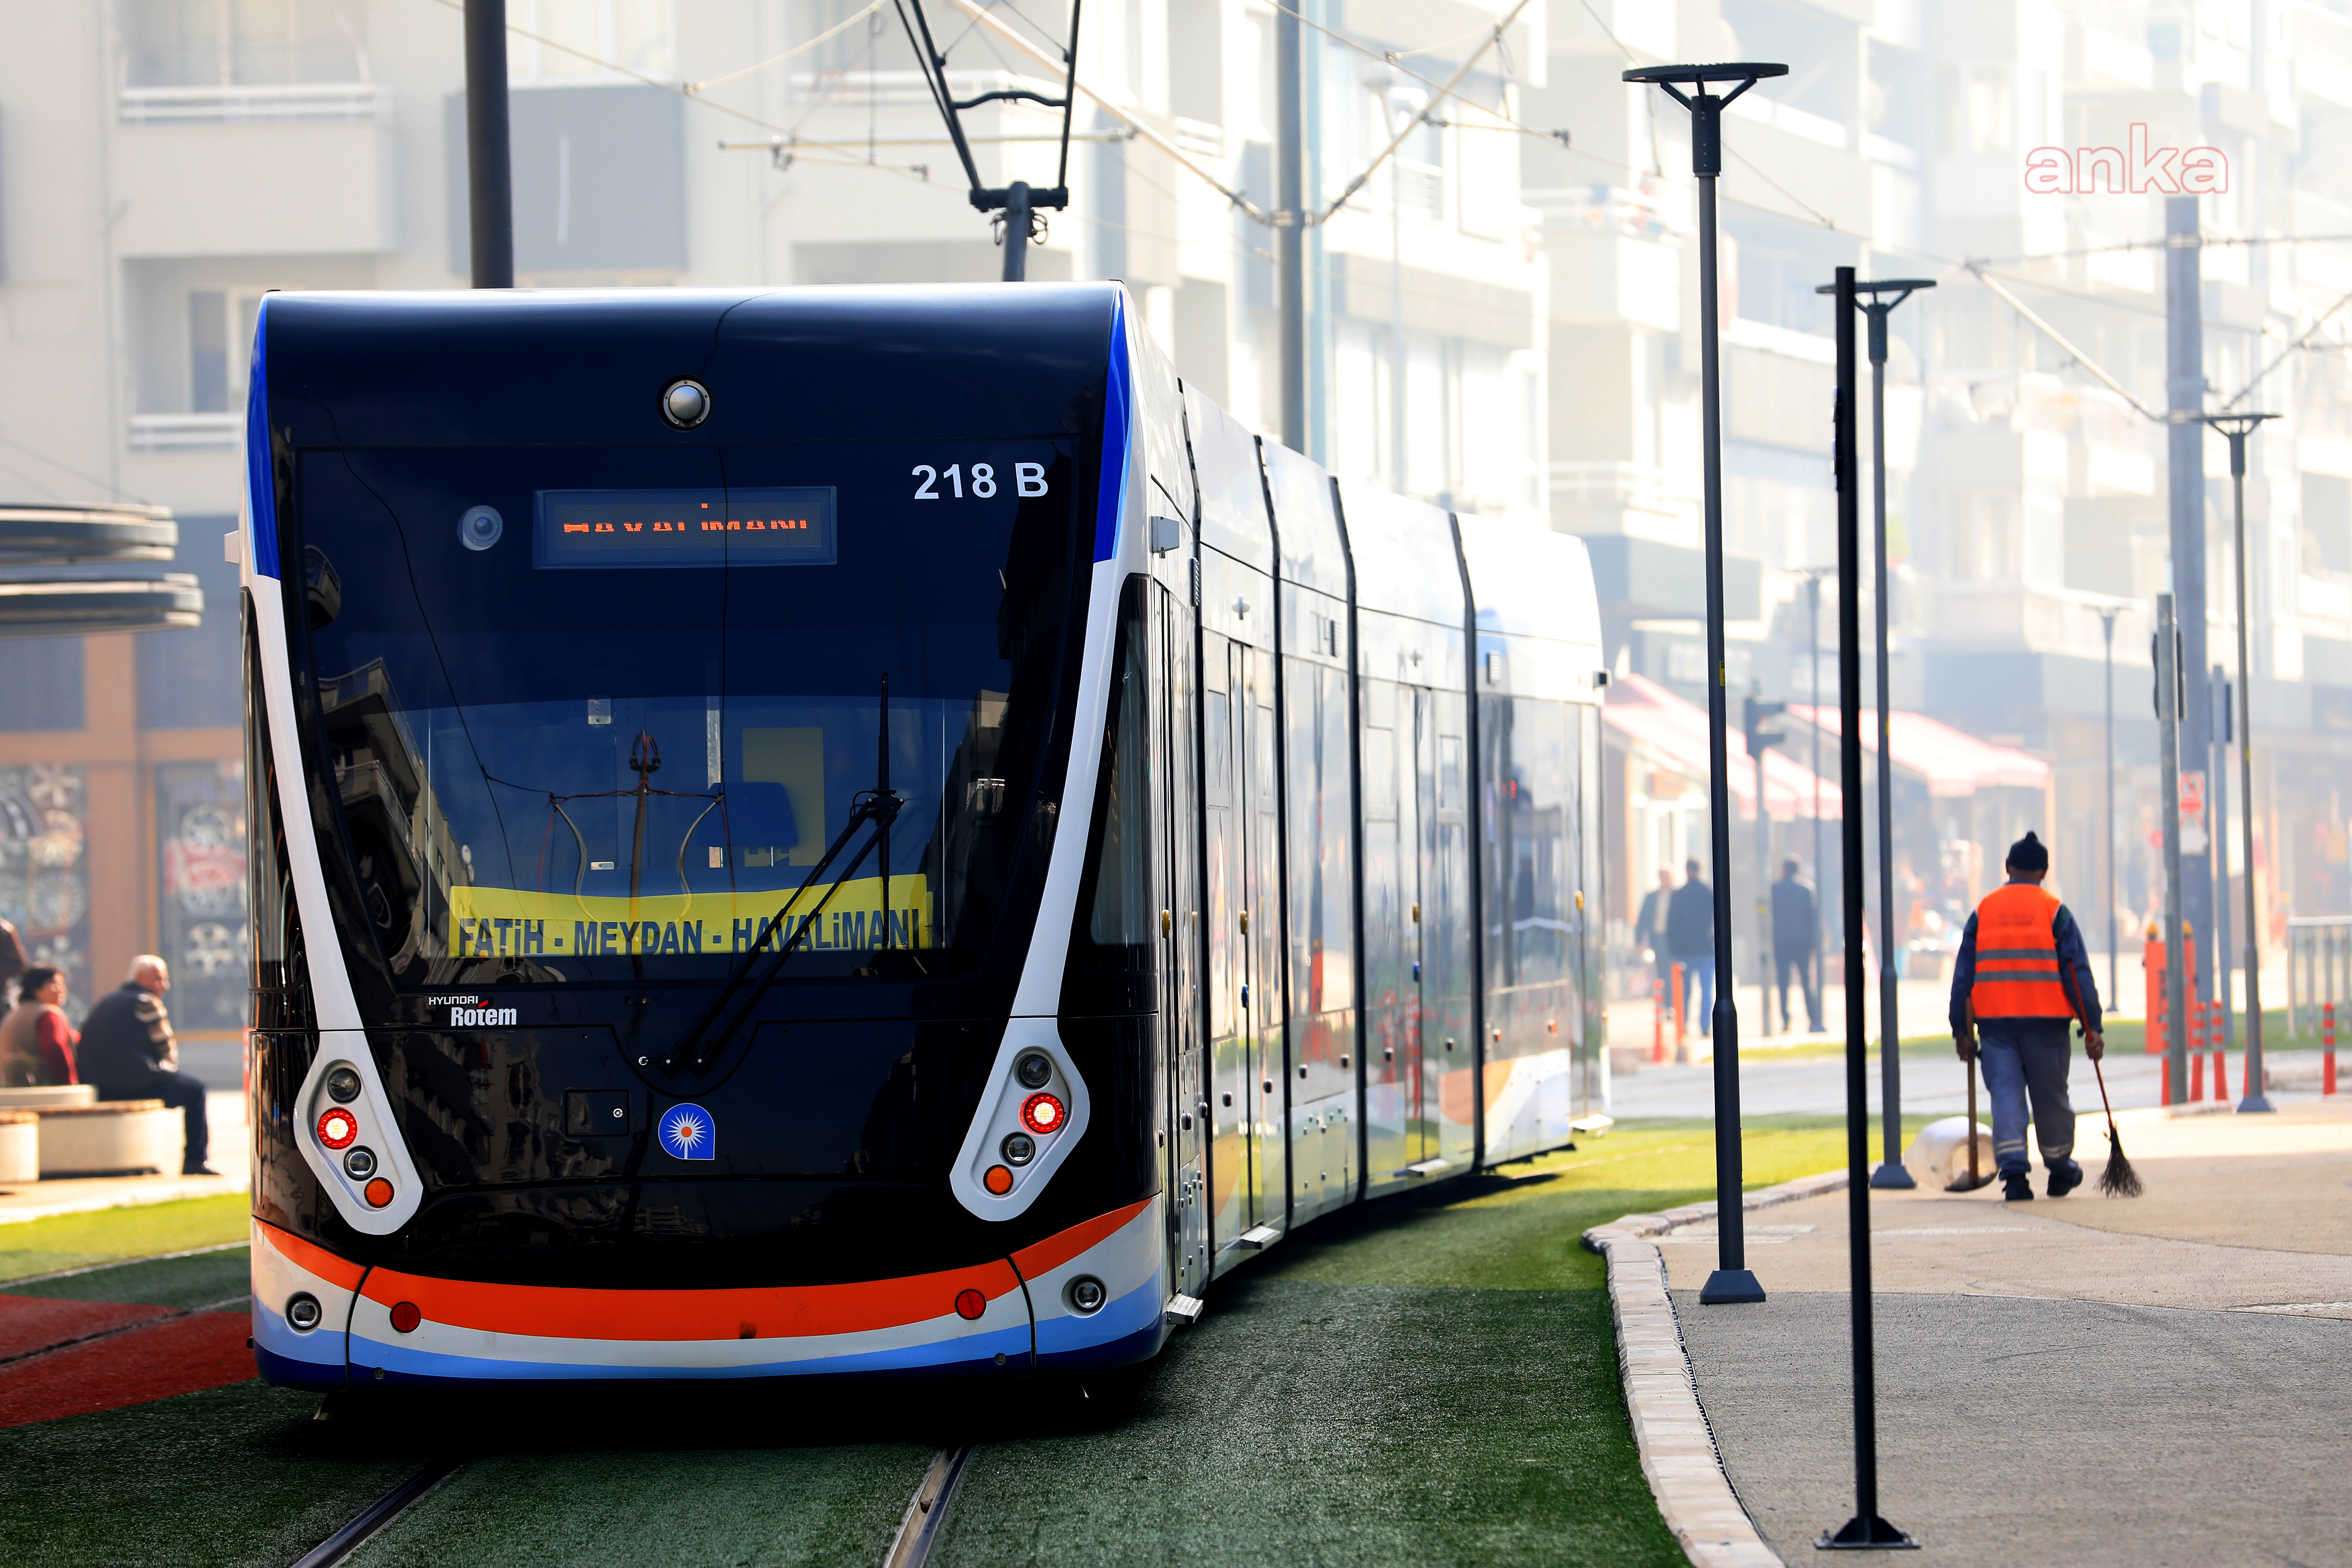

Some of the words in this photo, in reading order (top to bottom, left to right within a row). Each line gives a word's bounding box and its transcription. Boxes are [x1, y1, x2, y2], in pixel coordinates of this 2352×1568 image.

[912, 462, 997, 499] 218
[1015, 462, 1049, 497] B
[574, 919, 703, 956] MEYDAN
[429, 995, 478, 1005] HYUNDAI
[451, 1007, 517, 1027] Rotem
